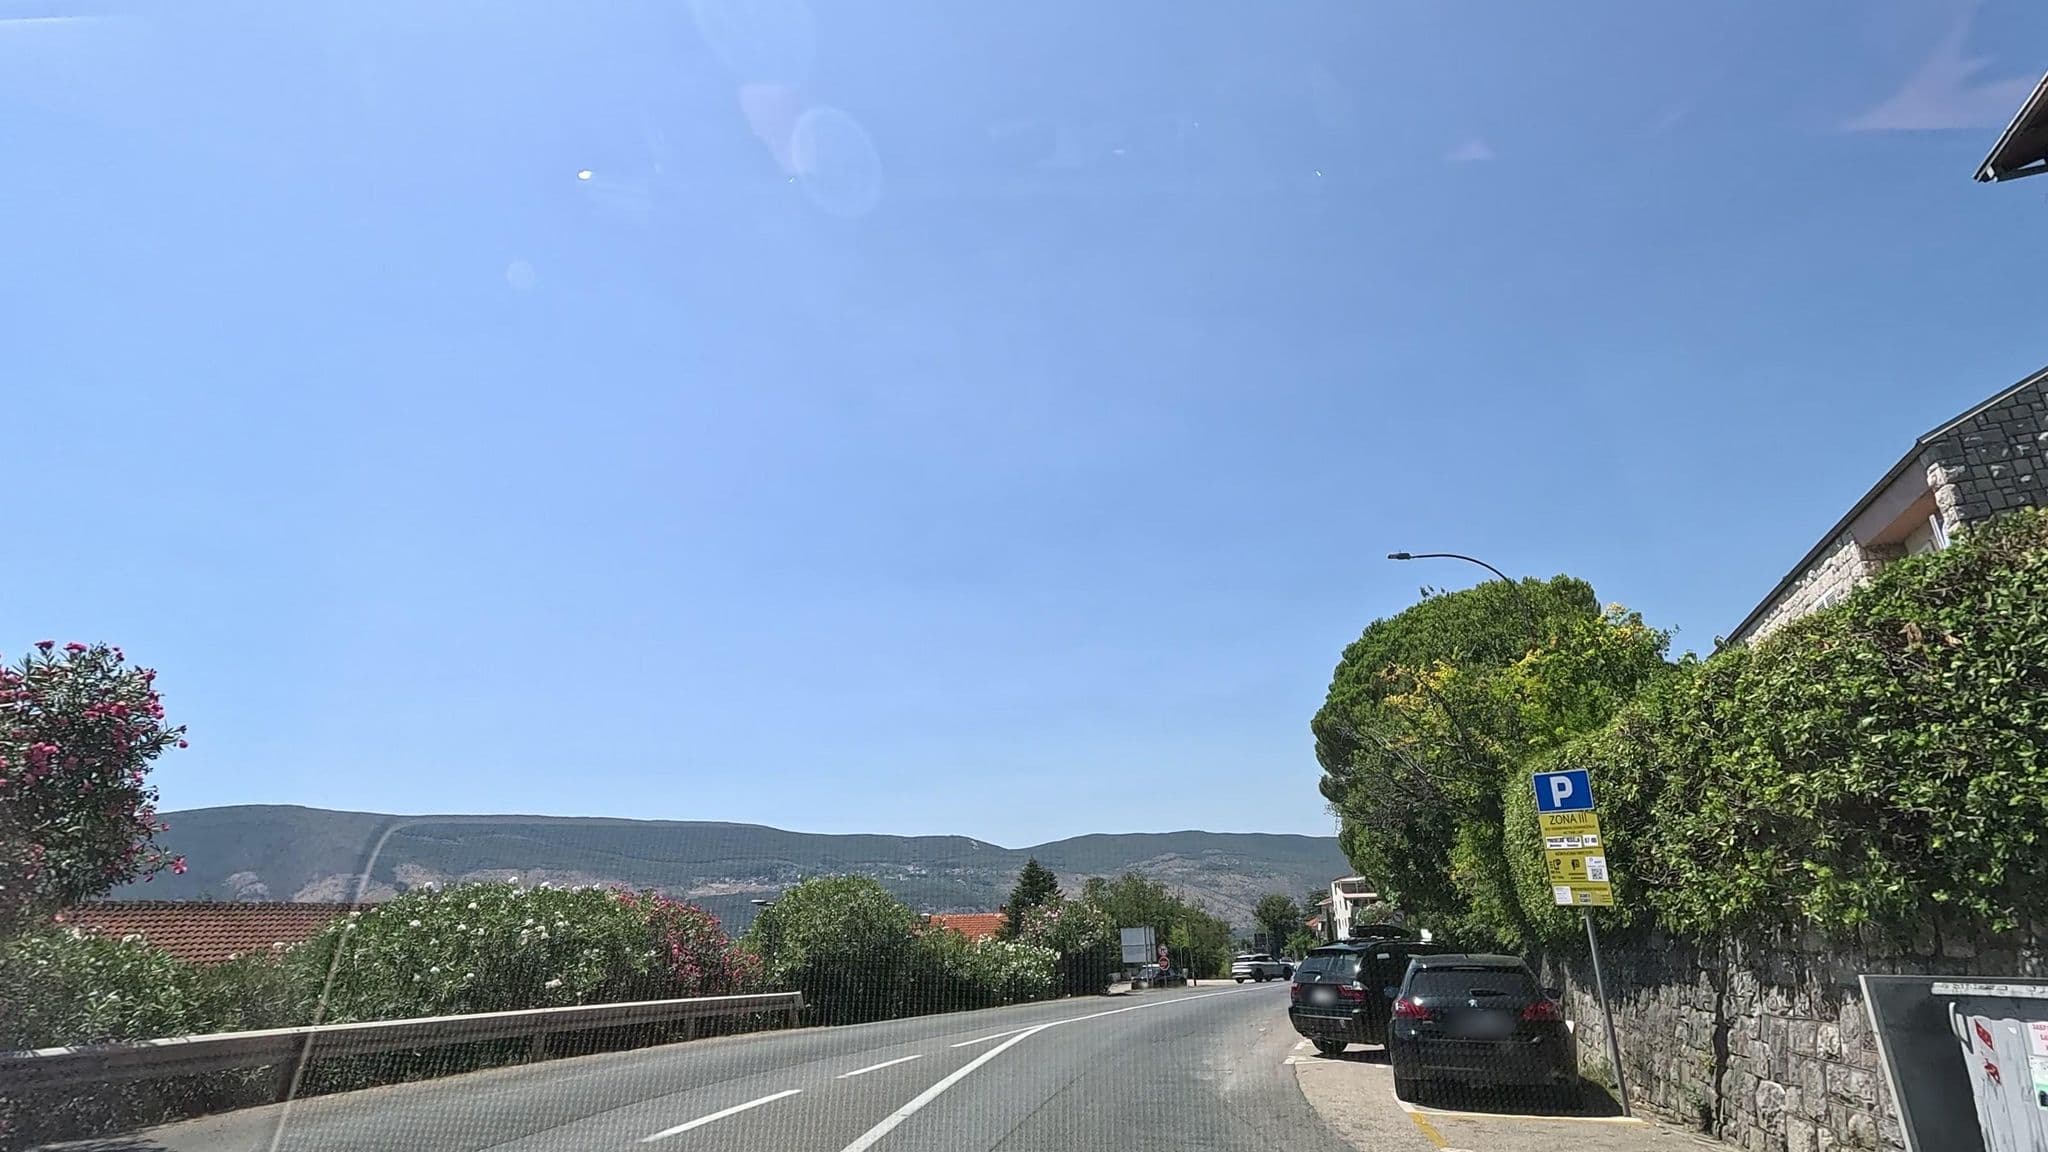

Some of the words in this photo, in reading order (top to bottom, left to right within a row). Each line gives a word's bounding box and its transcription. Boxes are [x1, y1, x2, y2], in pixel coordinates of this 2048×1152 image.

[1549, 775, 1573, 808] P
[1549, 814, 1577, 825] ZONA
[1578, 812, 1588, 824] III
